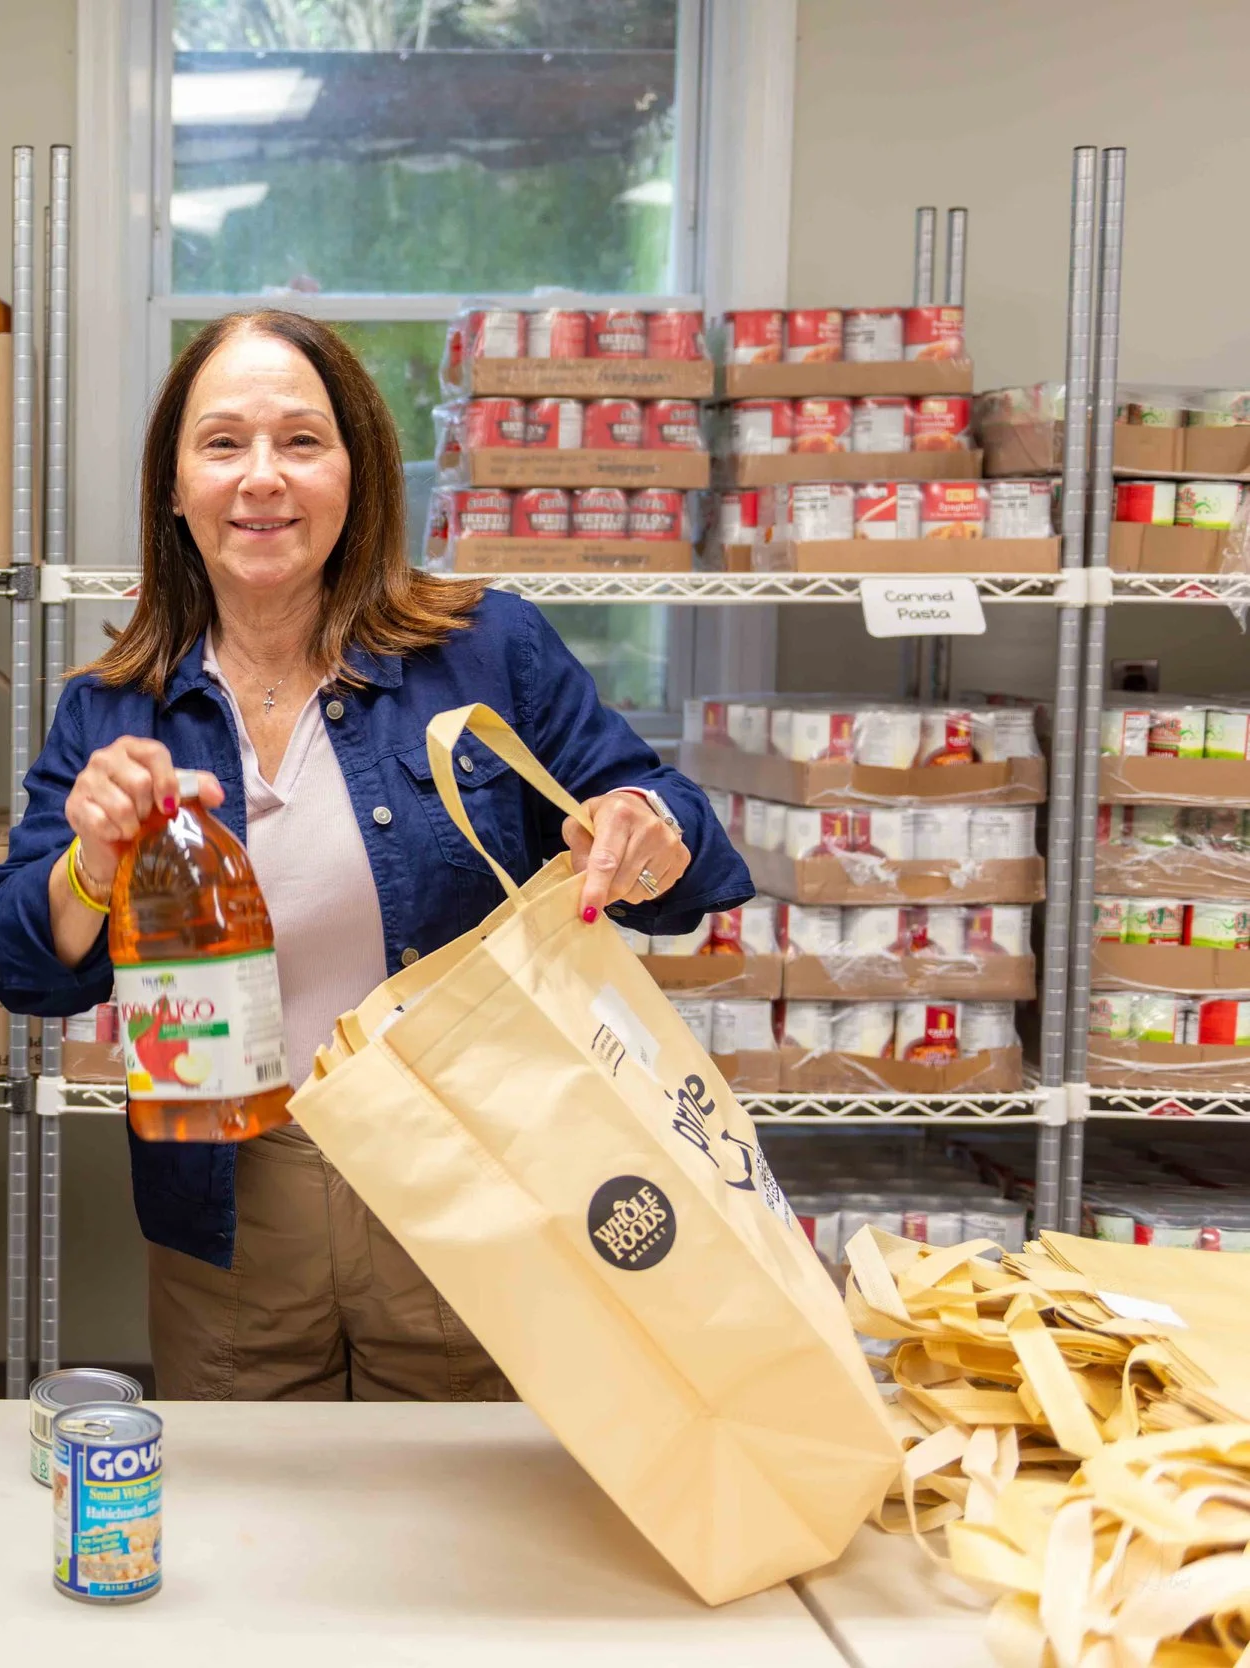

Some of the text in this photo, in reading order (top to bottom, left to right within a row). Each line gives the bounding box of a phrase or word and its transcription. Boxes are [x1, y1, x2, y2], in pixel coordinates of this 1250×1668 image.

[884, 589, 954, 602] Canned
[897, 607, 951, 620] Pasta
[593, 1185, 658, 1244] WHOLE
[606, 1202, 667, 1261] FOODS
[90, 1484, 121, 1501] Small
